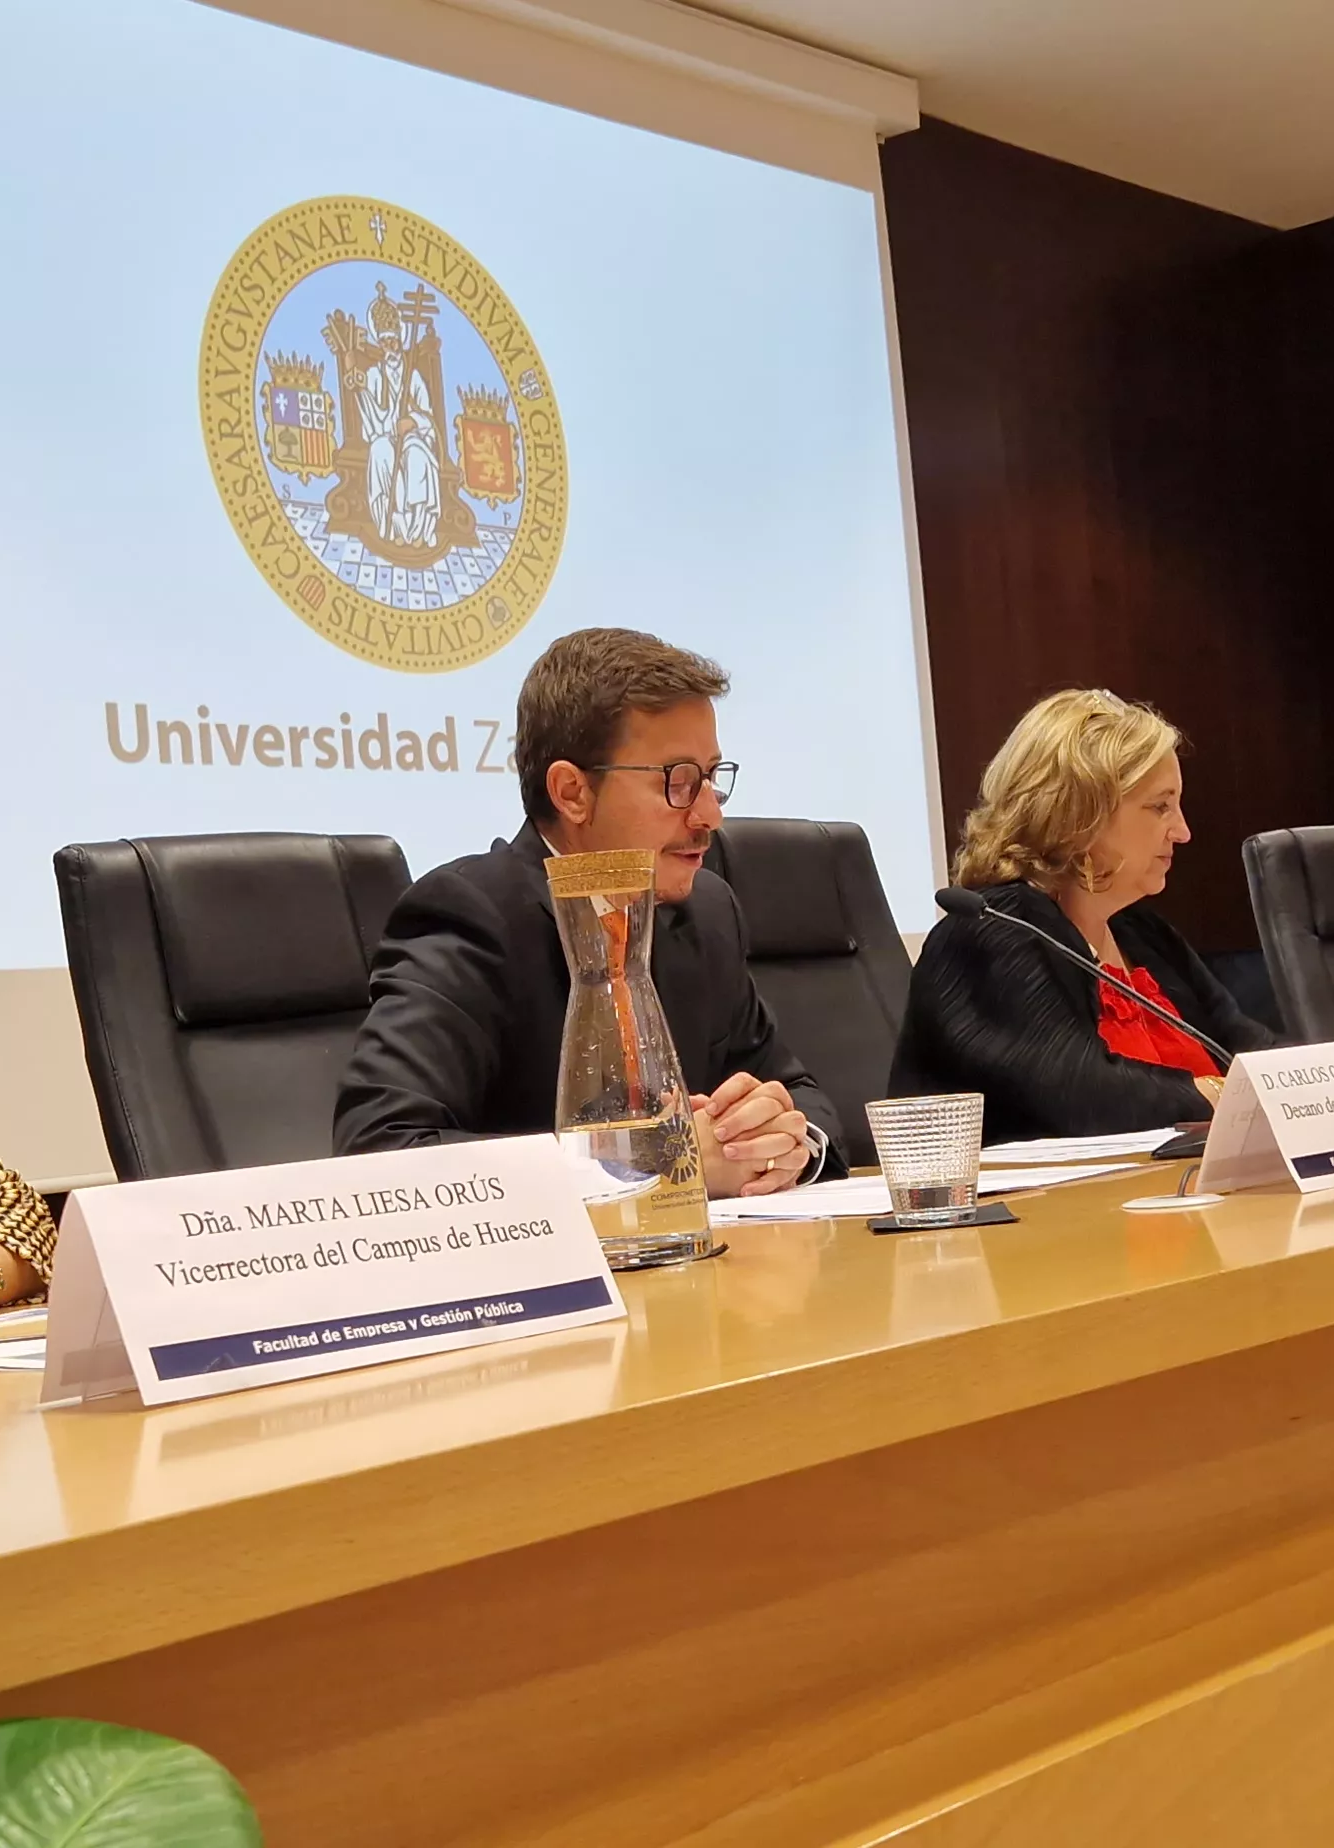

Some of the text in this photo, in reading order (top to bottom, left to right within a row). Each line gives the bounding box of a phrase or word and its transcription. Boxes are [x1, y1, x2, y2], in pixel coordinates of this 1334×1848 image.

[504, 408, 559, 605] GENERALE
[105, 702, 459, 772] Universidad
[1261, 1073, 1280, 1090] D.
[1278, 1066, 1329, 1088] CARLOS
[1281, 1100, 1324, 1120] Decano
[179, 1174, 505, 1238] Dña. MARTA LIESA ORÚS
[155, 1218, 555, 1287] Vicerrectora del Campus de Huesca
[252, 1301, 525, 1354] Facultad de Empresa y Gestión Pública
